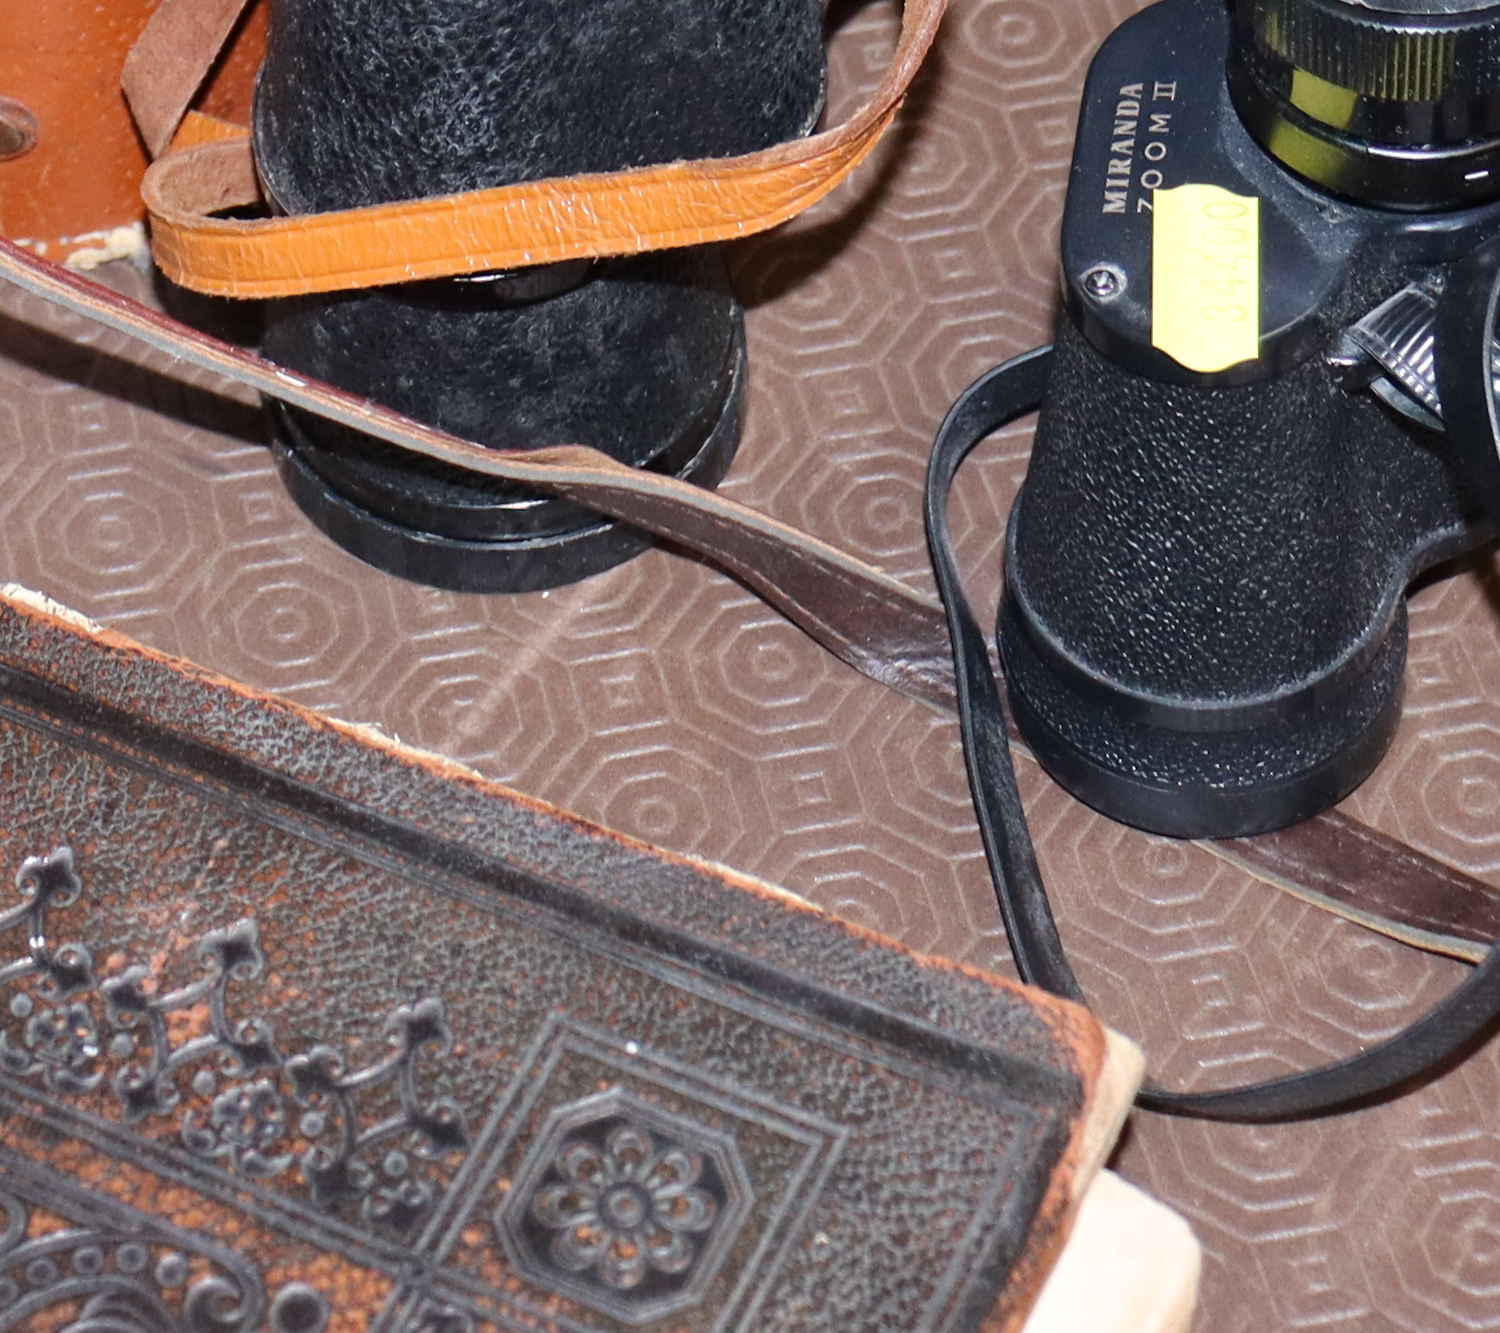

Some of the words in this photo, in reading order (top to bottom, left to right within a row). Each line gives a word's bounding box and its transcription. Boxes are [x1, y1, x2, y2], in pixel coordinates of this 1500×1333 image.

[1152, 81, 1177, 102] II
[1102, 82, 1144, 214] MIRANDA
[1136, 113, 1172, 214] ZOOM
[1201, 202, 1250, 322] 34400
